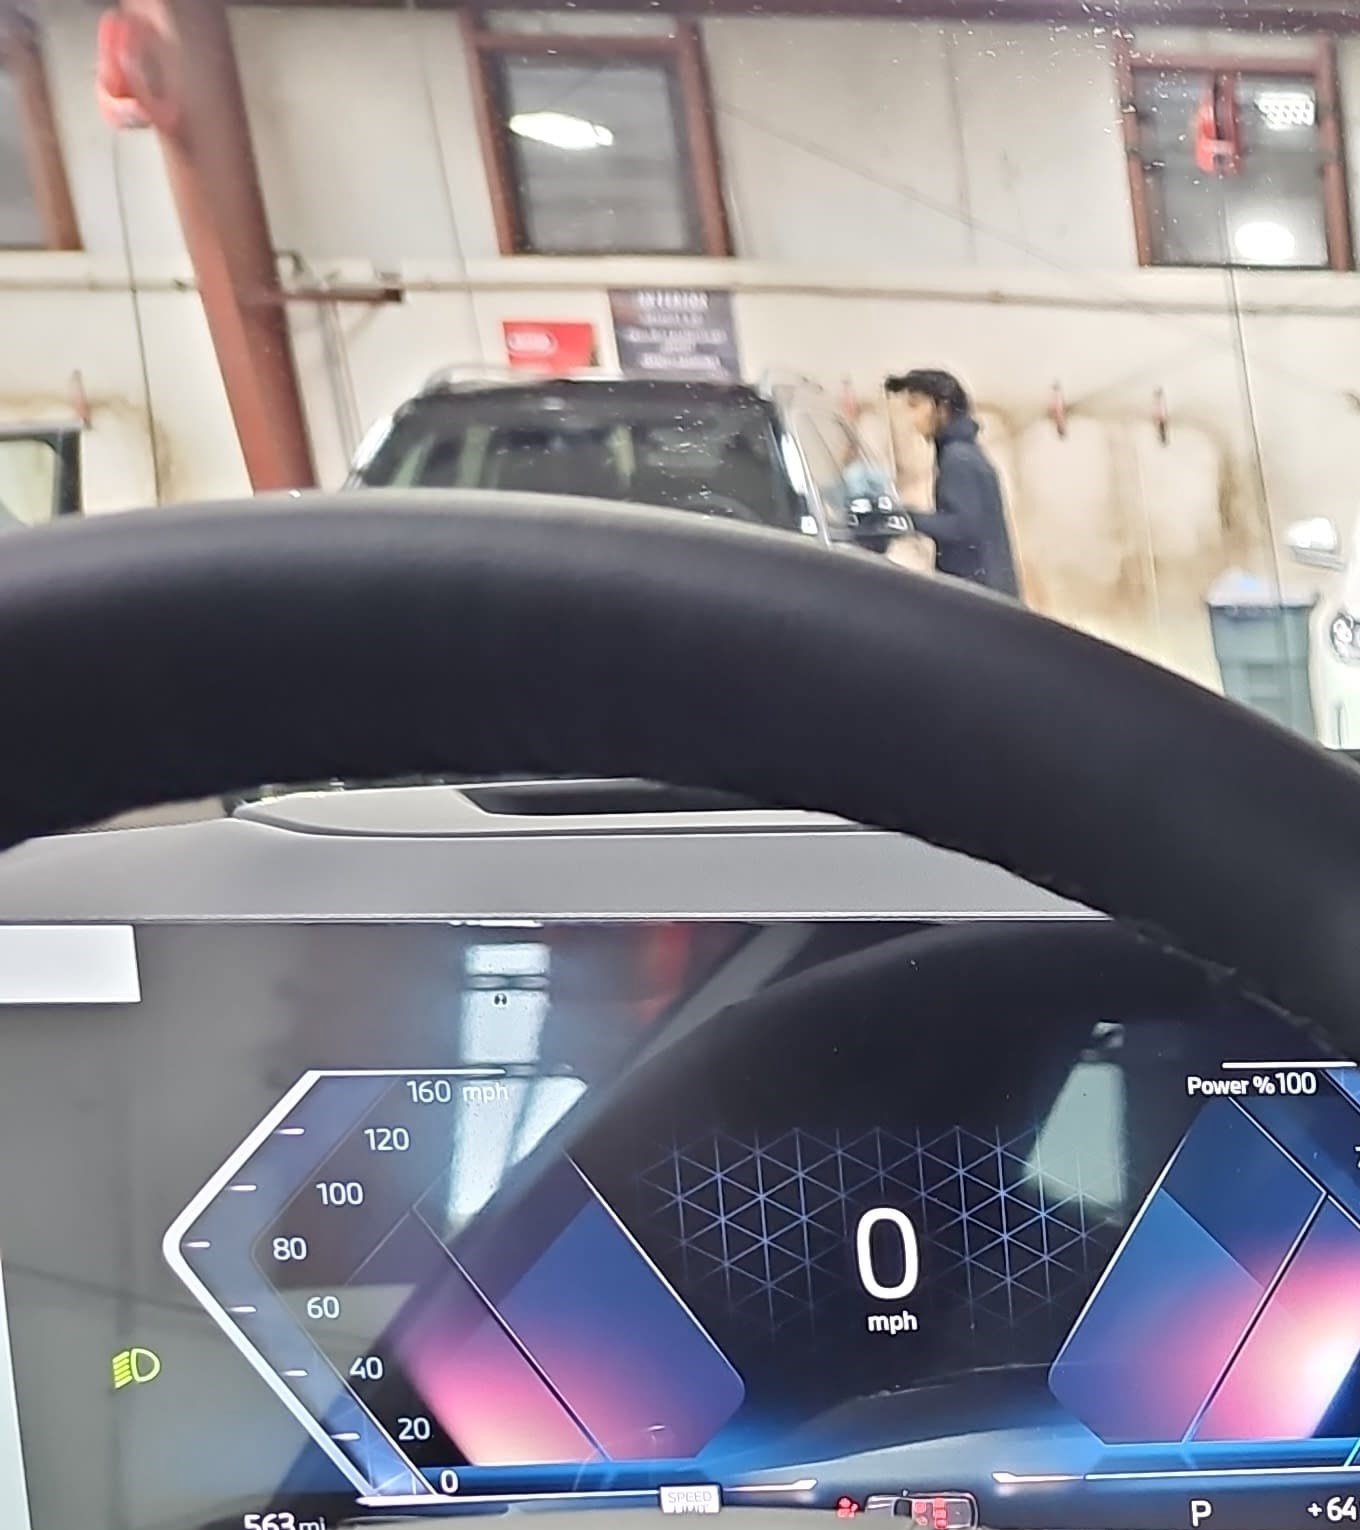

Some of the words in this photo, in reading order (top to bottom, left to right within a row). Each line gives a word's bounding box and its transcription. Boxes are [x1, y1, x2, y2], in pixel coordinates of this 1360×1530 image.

[408, 1080, 451, 1104] 160
[463, 1083, 508, 1106] mph
[1187, 1076, 1249, 1096] Power
[365, 1128, 410, 1151] 120
[316, 1182, 364, 1206] 100
[273, 1237, 307, 1262] 80
[856, 1207, 919, 1302] 0
[307, 1296, 340, 1320] 60
[867, 1310, 918, 1335] mph
[349, 1357, 383, 1381] 40
[398, 1417, 431, 1441] 20
[441, 1471, 459, 1493] 0
[667, 1491, 712, 1503] SPEED
[1191, 1501, 1212, 1527] P
